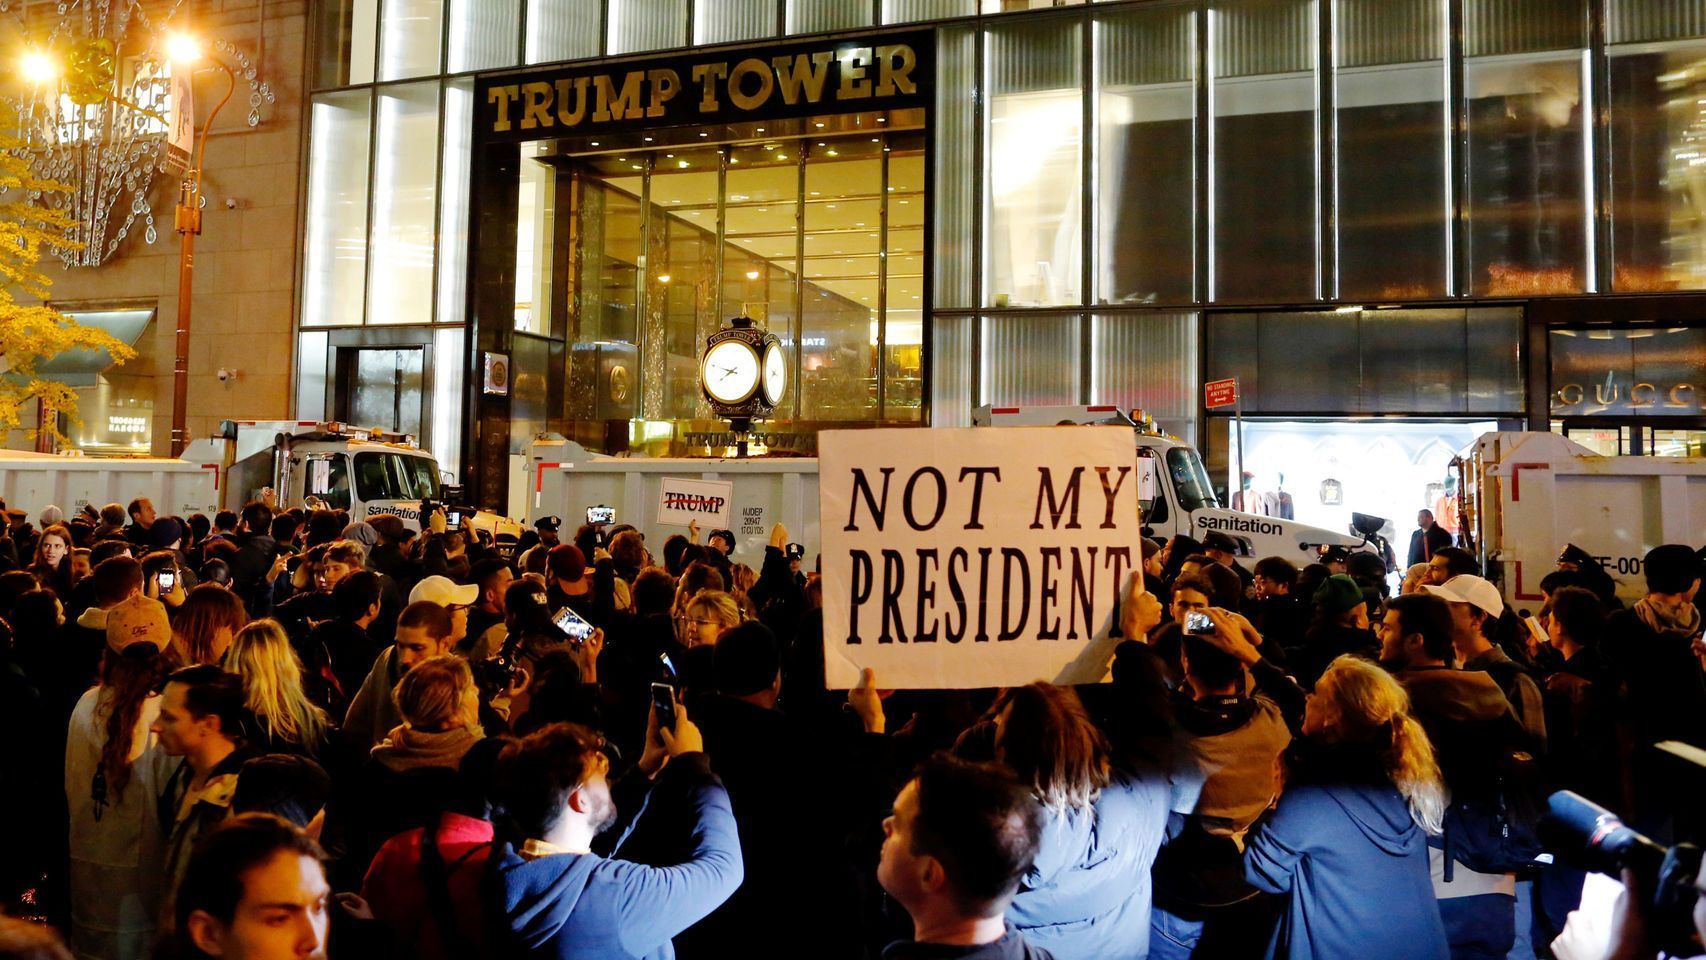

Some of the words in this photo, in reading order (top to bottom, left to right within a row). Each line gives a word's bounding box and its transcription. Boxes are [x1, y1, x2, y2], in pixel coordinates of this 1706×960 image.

[488, 68, 682, 132] TRUMP
[692, 43, 917, 112] TOWER
[1560, 383, 1695, 405] GUCC
[683, 432, 739, 447] TRUM
[665, 492, 725, 514] TRUMP
[843, 466, 1002, 532] NOT
[1029, 466, 1132, 530] MY
[742, 507, 763, 516] NJDEP
[1197, 516, 1283, 536] sanitation
[1592, 556, 1644, 575] F-00
[846, 546, 1132, 645] PRESIDENT
